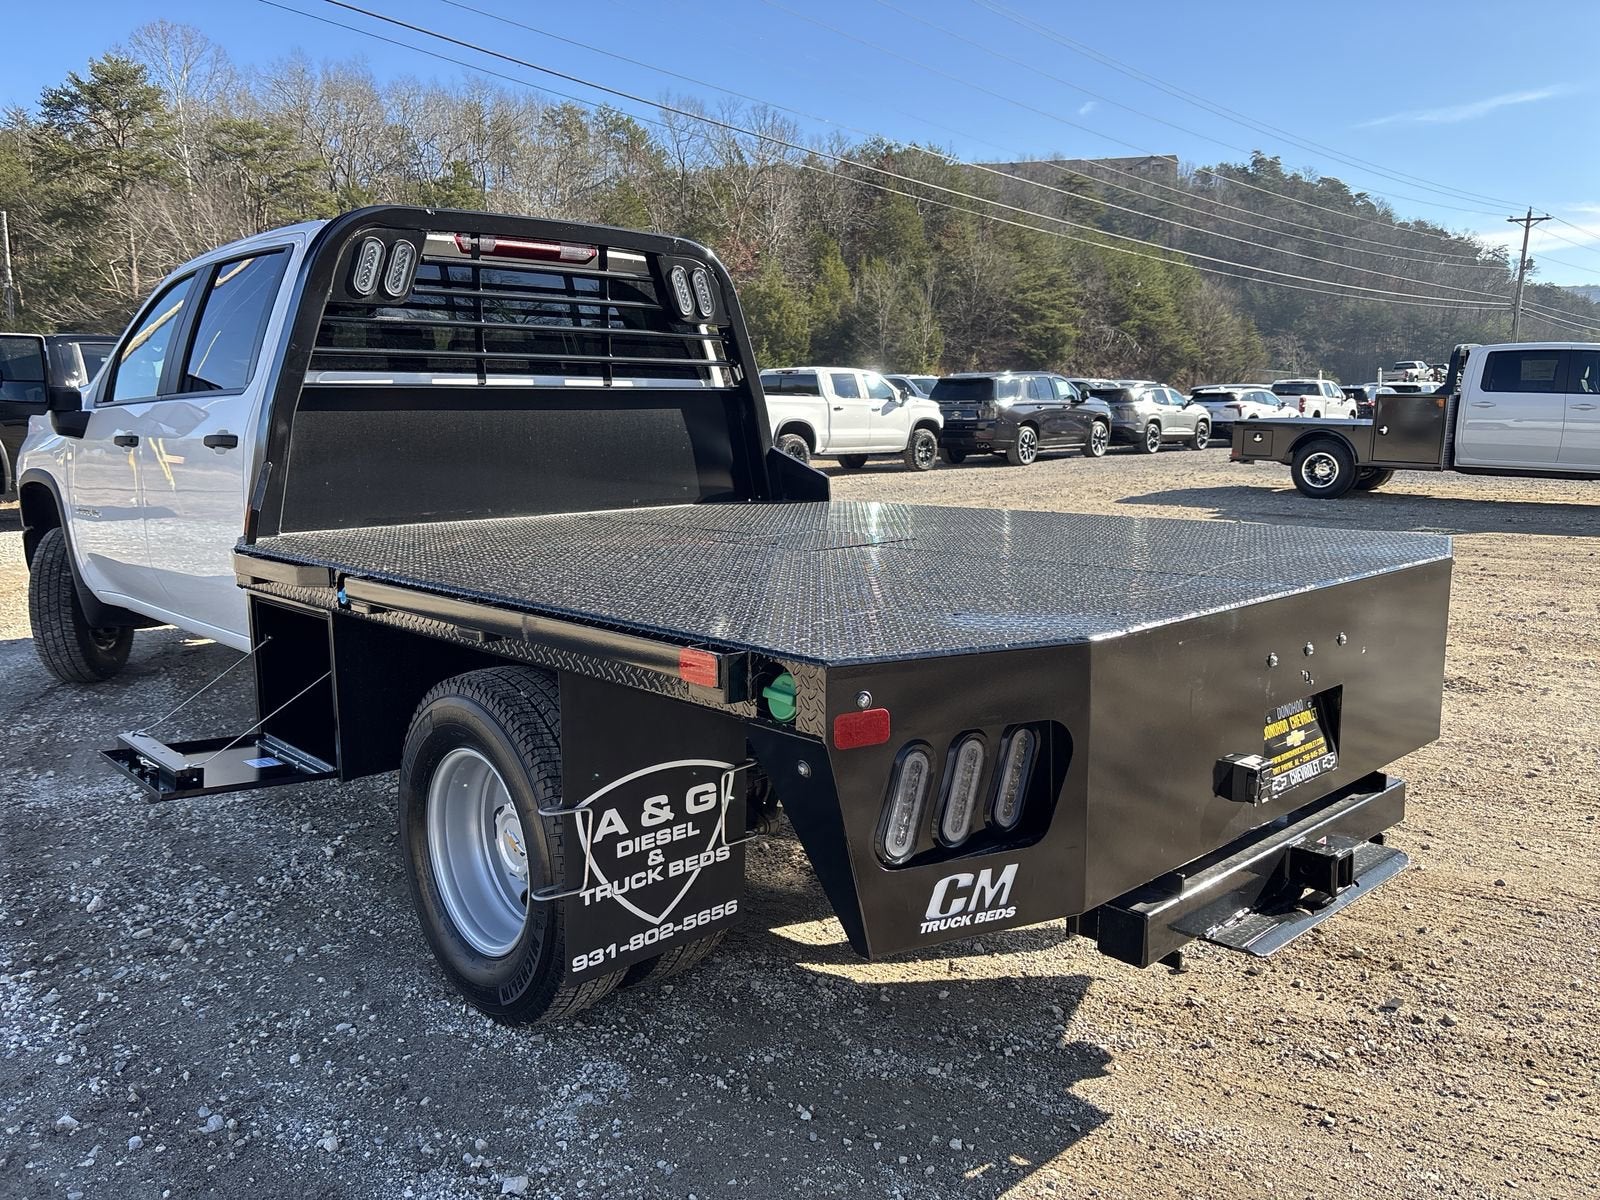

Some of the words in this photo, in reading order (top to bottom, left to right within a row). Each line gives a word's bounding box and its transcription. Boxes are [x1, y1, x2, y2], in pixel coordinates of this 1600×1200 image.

[1276, 699, 1304, 720] DONOHOO
[1289, 707, 1318, 729] CHEVROLET
[1289, 760, 1320, 785] CHEVROLET
[592, 808, 629, 844] A
[640, 794, 675, 828] &
[685, 782, 717, 815] G
[616, 821, 700, 859] DIESEL
[647, 848, 666, 867] &
[579, 866, 665, 906] TRUCK
[668, 846, 730, 879] BEDS
[925, 863, 1020, 920] CM
[571, 899, 738, 973] 931-802-5656
[920, 914, 973, 934] TRUCK
[974, 906, 1017, 924] BEDS
[501, 933, 541, 1002] MICHELIN
